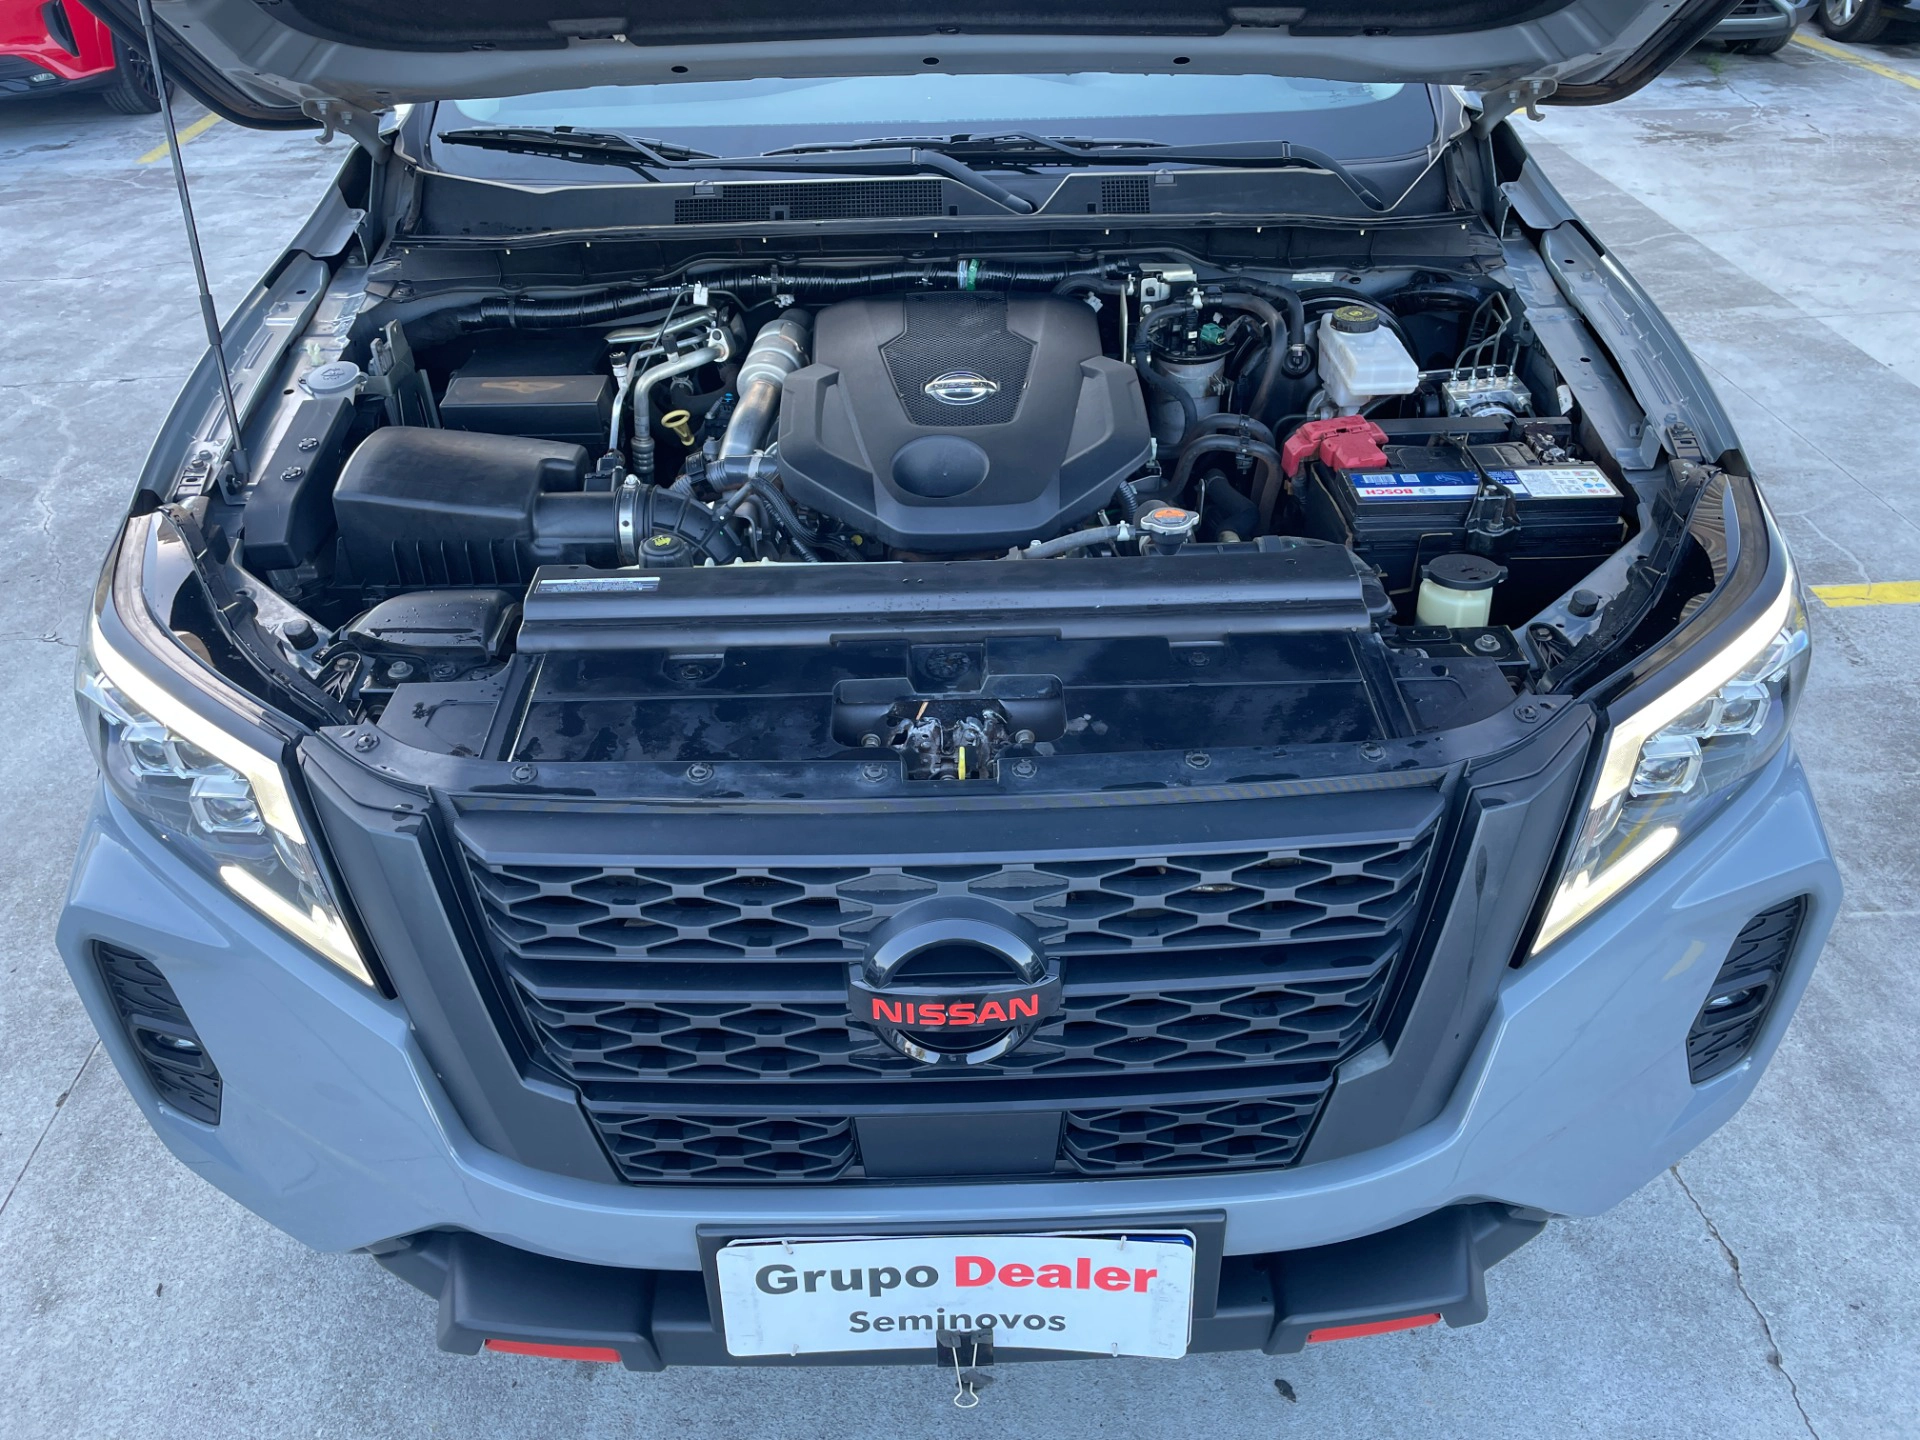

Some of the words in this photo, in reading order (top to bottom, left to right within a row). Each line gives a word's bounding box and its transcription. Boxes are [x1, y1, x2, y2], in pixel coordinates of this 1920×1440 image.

[872, 994, 1039, 1025] NISSAN
[755, 1263, 939, 1297] Grupo
[955, 1256, 1158, 1293] Dealer
[849, 1307, 1066, 1333] Seminovos
